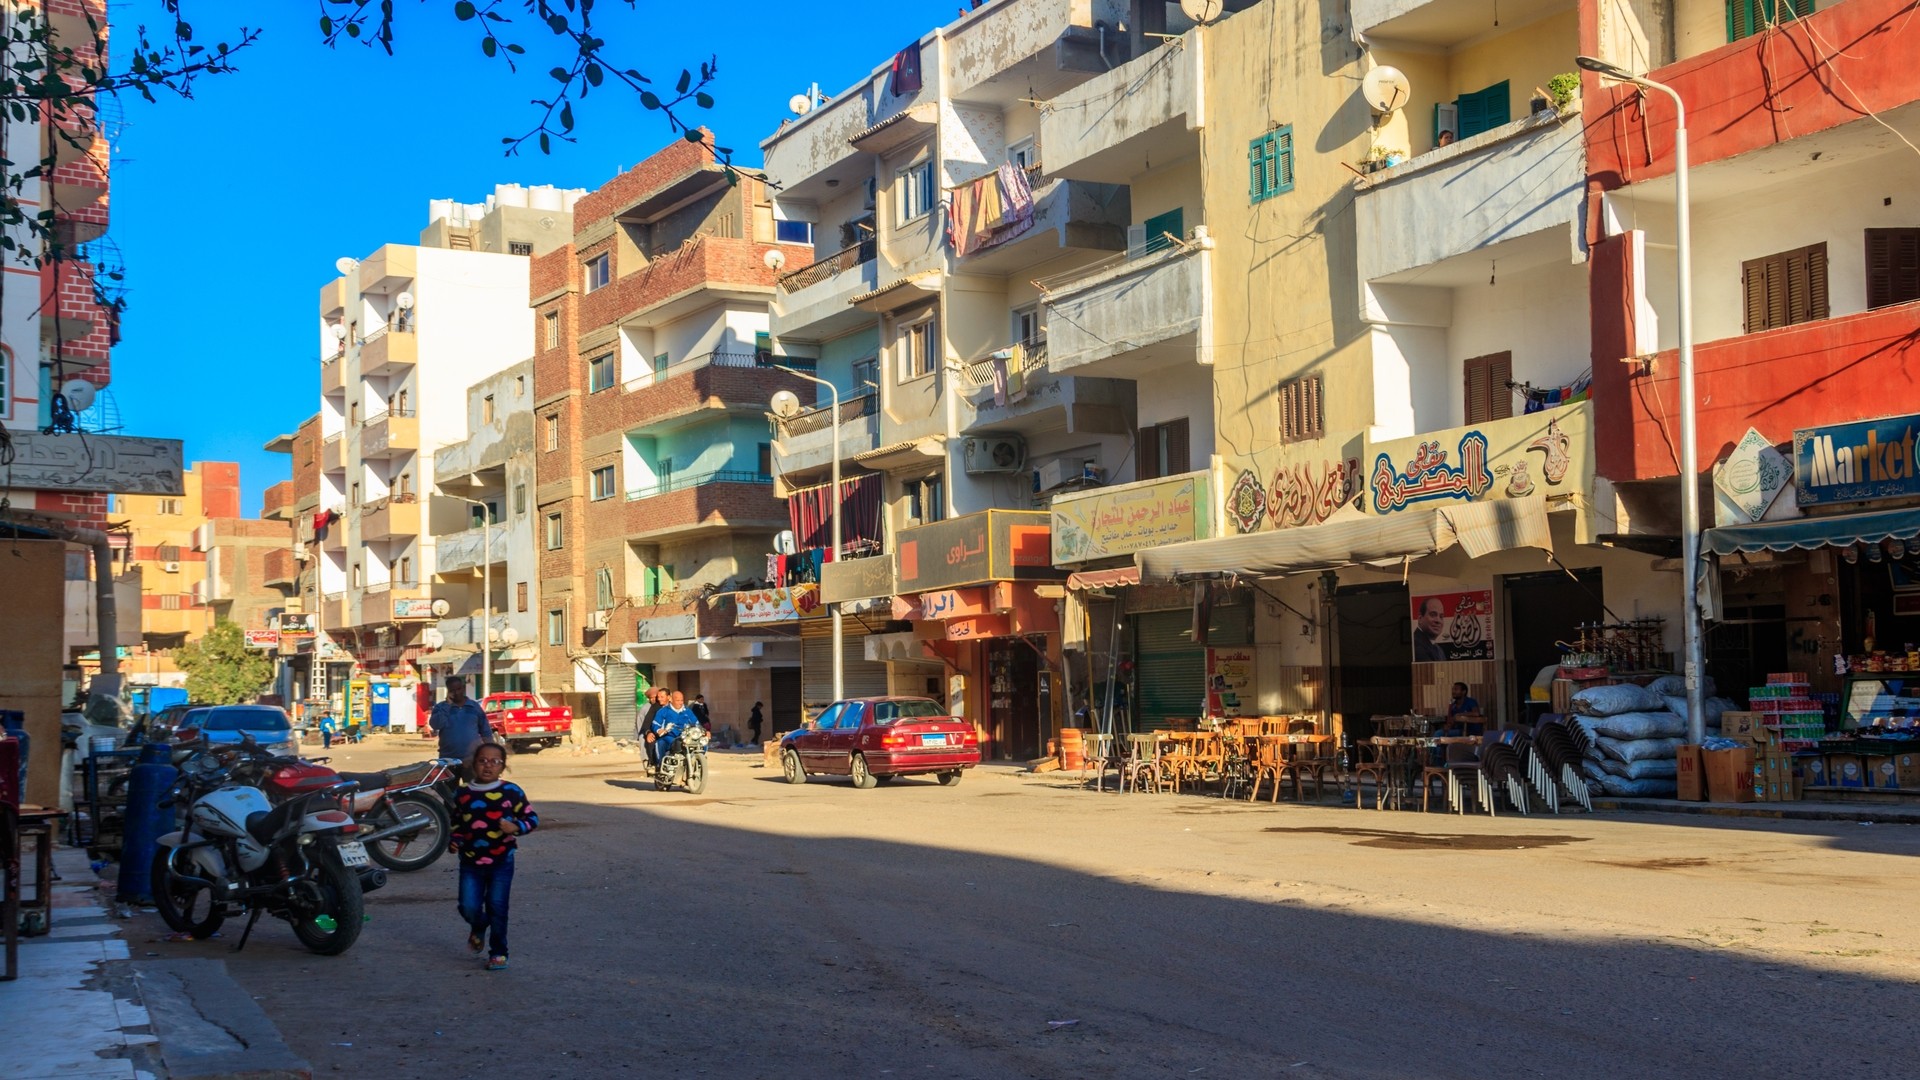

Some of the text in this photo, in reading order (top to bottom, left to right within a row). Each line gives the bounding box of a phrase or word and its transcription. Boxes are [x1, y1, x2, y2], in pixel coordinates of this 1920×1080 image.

[1811, 425, 1914, 487] Market
[1127, 499, 1164, 525] الرحمن
[1014, 554, 1045, 564] orange
